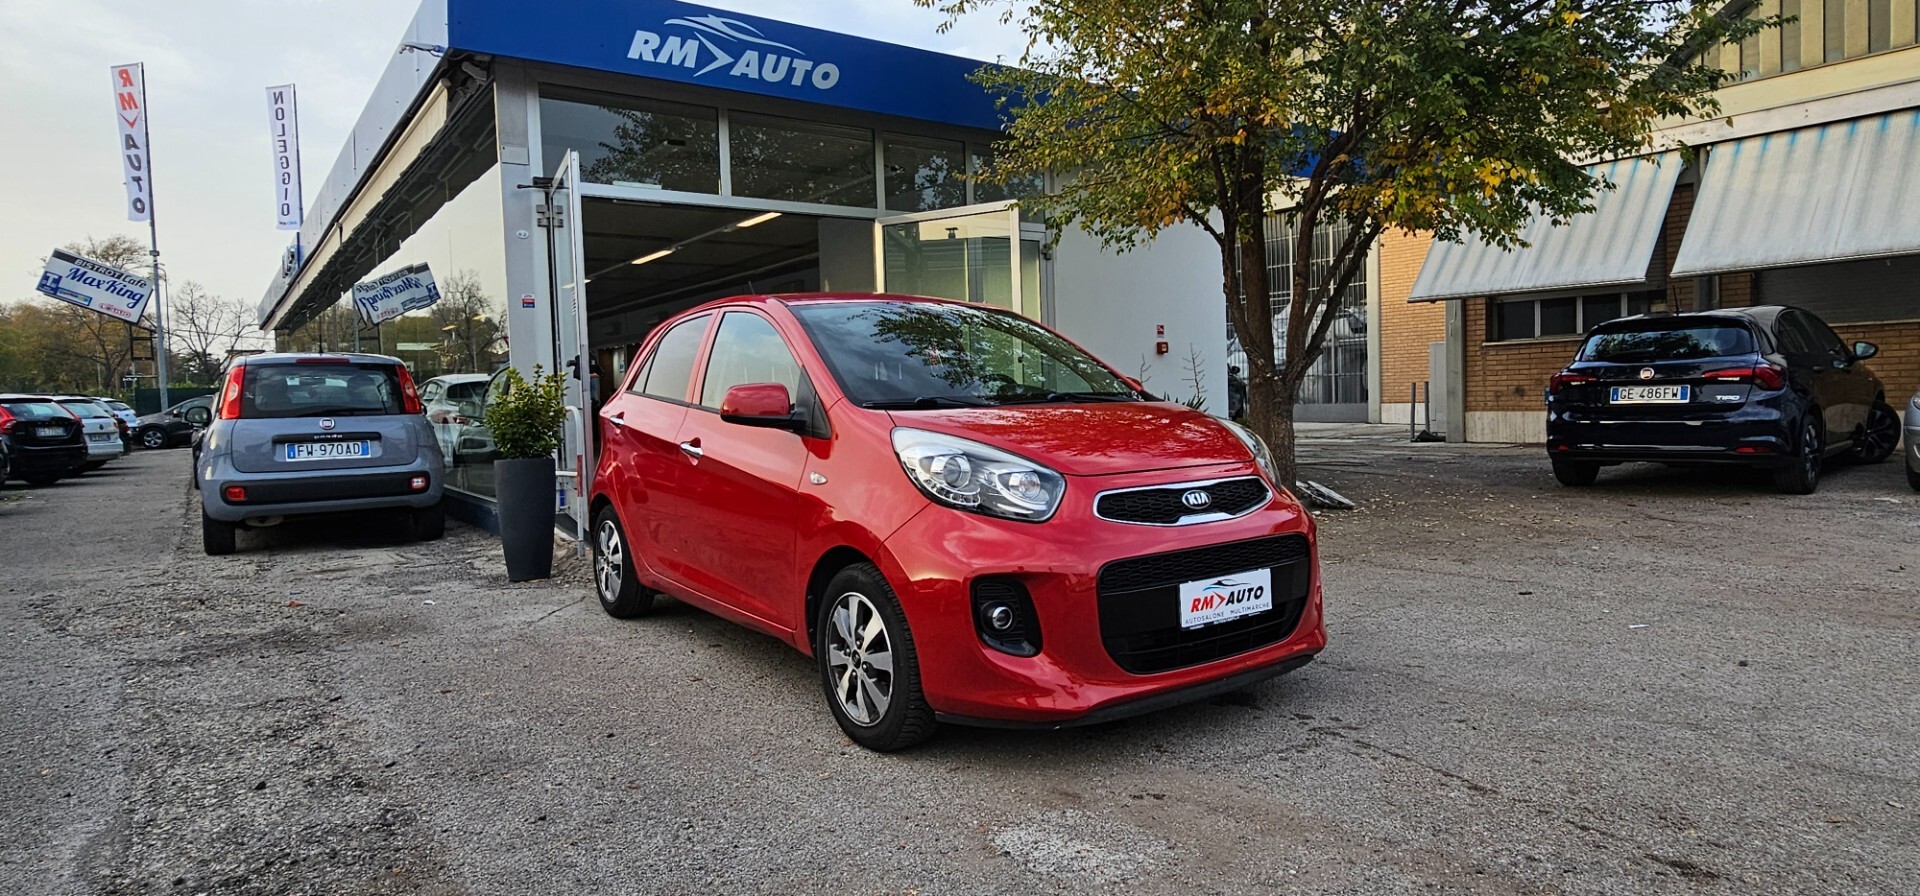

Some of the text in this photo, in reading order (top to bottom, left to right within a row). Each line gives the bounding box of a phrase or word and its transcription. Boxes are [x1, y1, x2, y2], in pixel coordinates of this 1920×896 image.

[627, 30, 840, 90] RM AUTO
[74, 259, 121, 278] BISTROT
[1186, 492, 1209, 506] KIA
[1190, 585, 1264, 613] RM AUTO
[1185, 611, 1225, 624] AUTOSALONE
[1230, 602, 1270, 615] MULTIMARCHE
